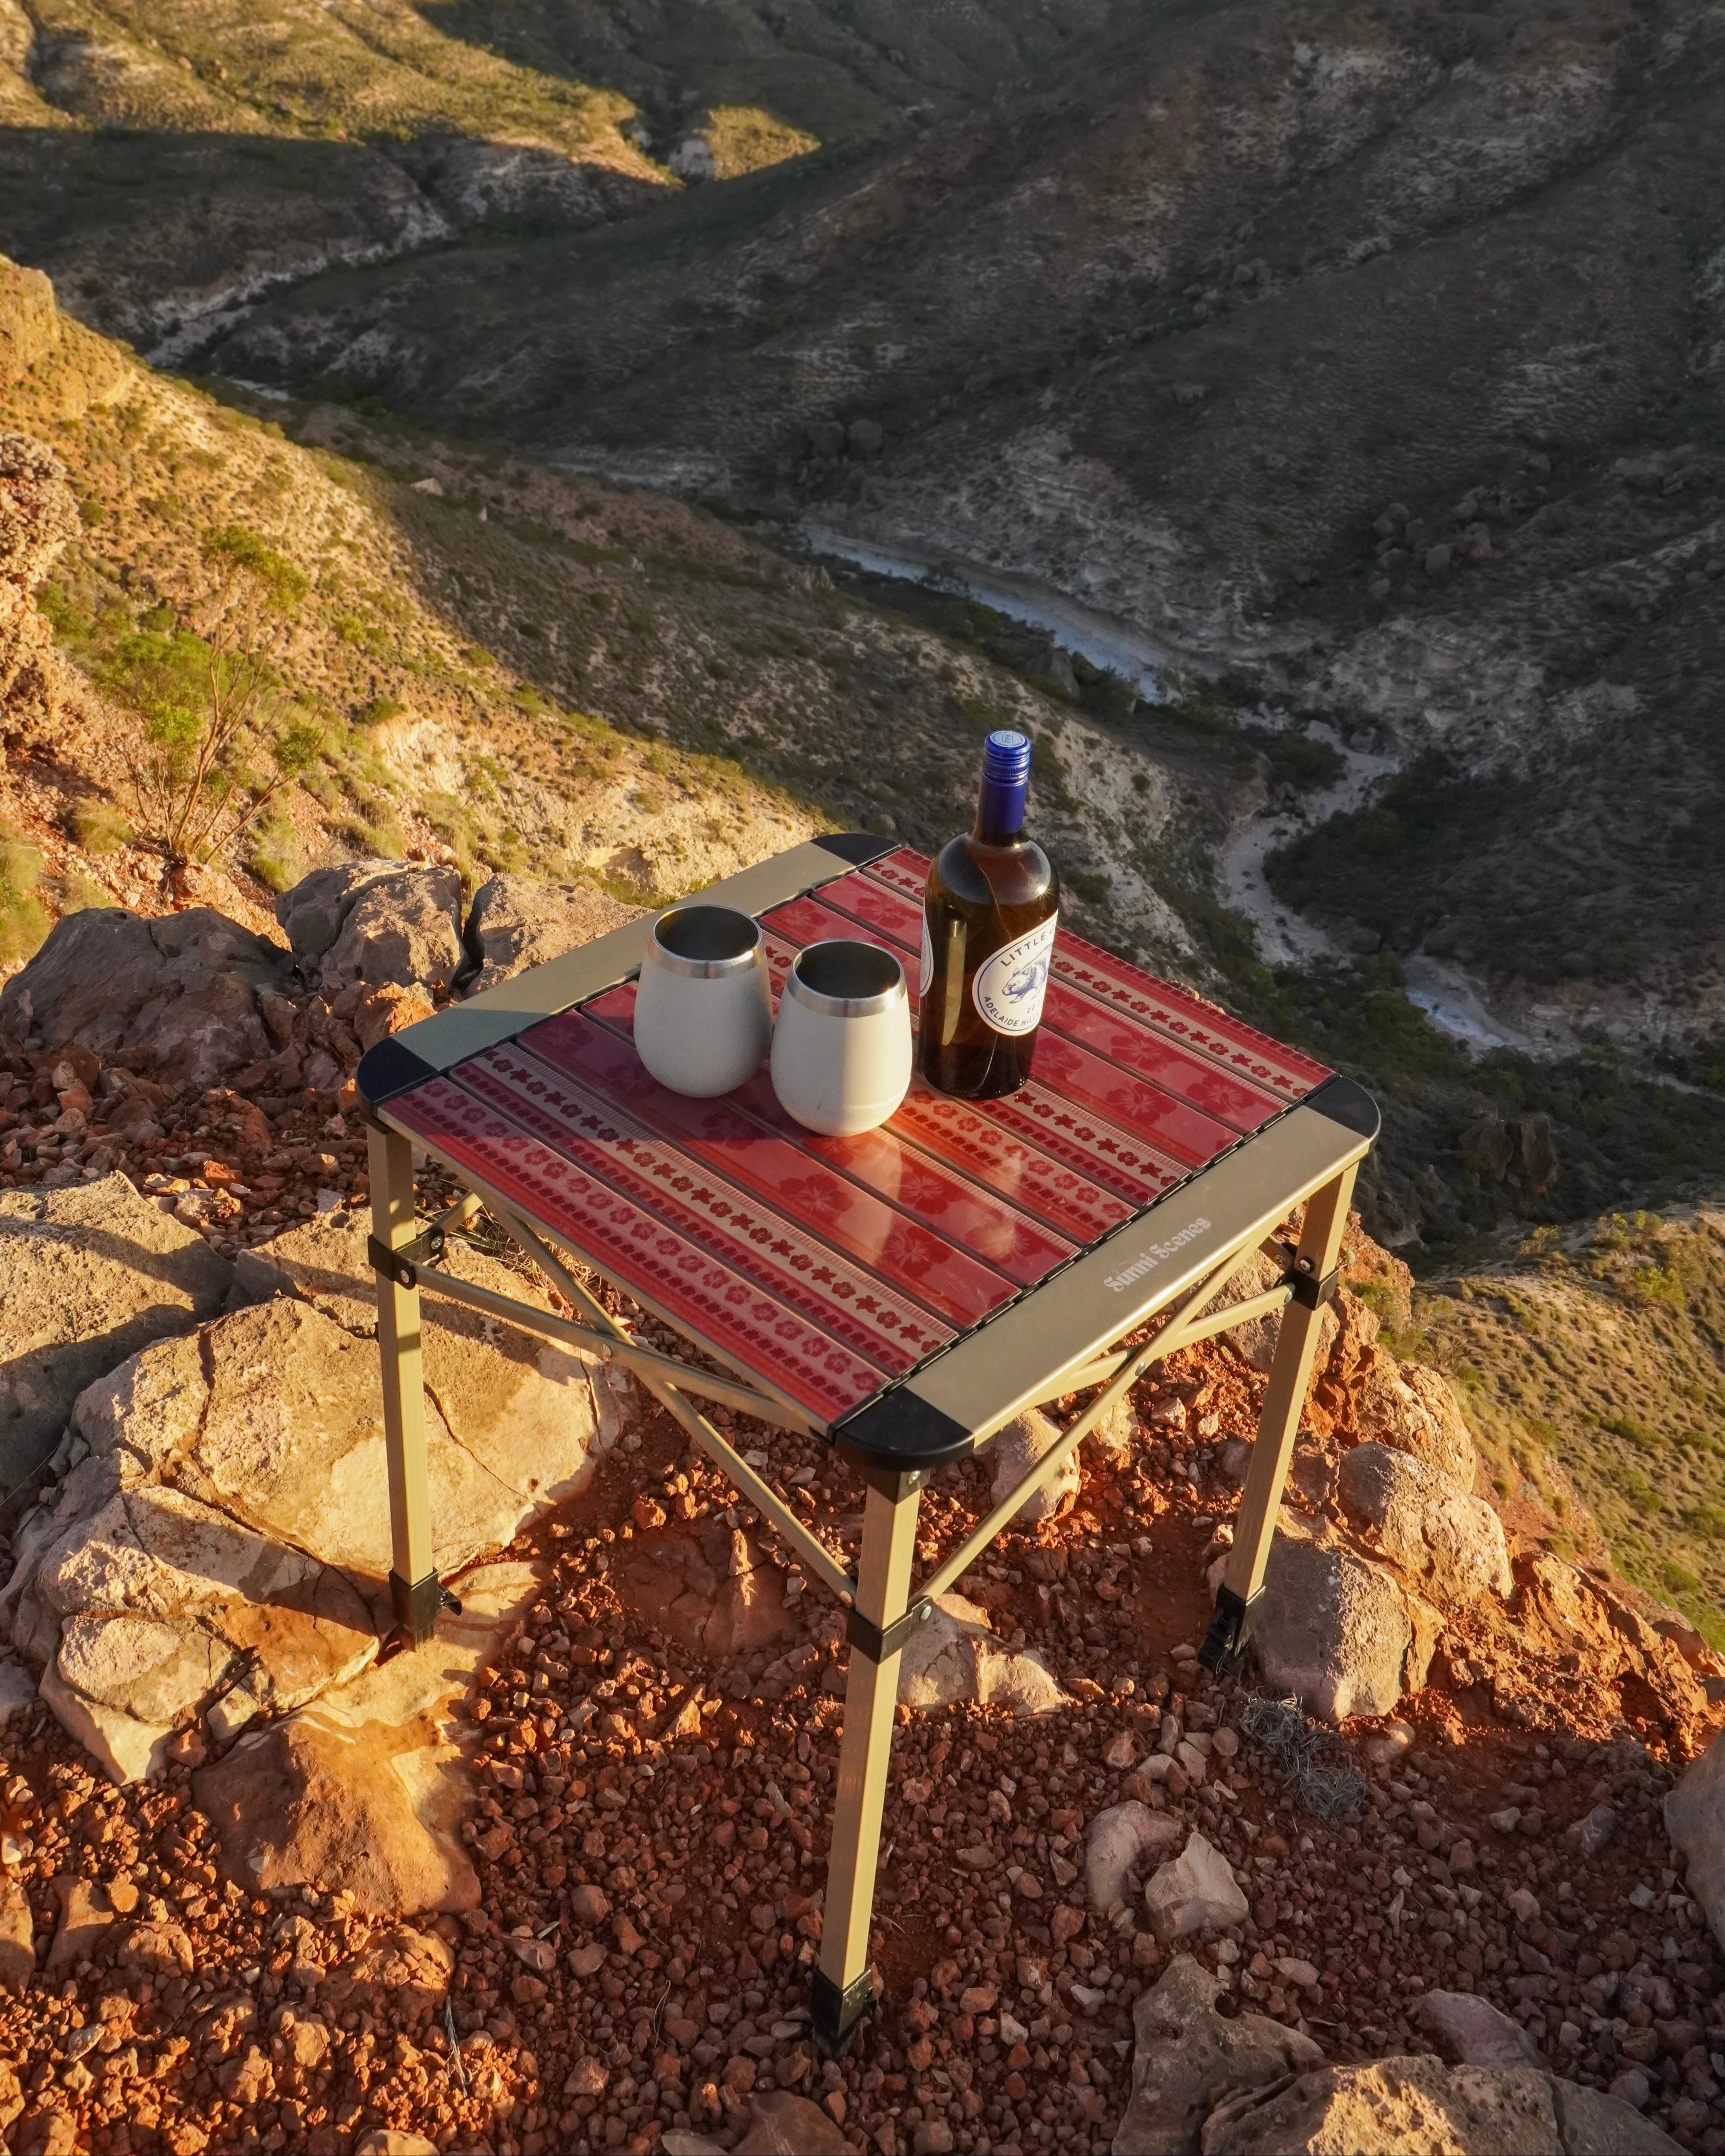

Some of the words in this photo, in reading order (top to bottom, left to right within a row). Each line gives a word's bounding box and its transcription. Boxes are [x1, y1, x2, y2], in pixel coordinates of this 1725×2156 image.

[1000, 931, 1045, 967] LITTLE
[984, 997, 1019, 1026] ADELAIDE
[1104, 1252, 1159, 1292] Sunni
[1149, 1217, 1211, 1259] Scenes
